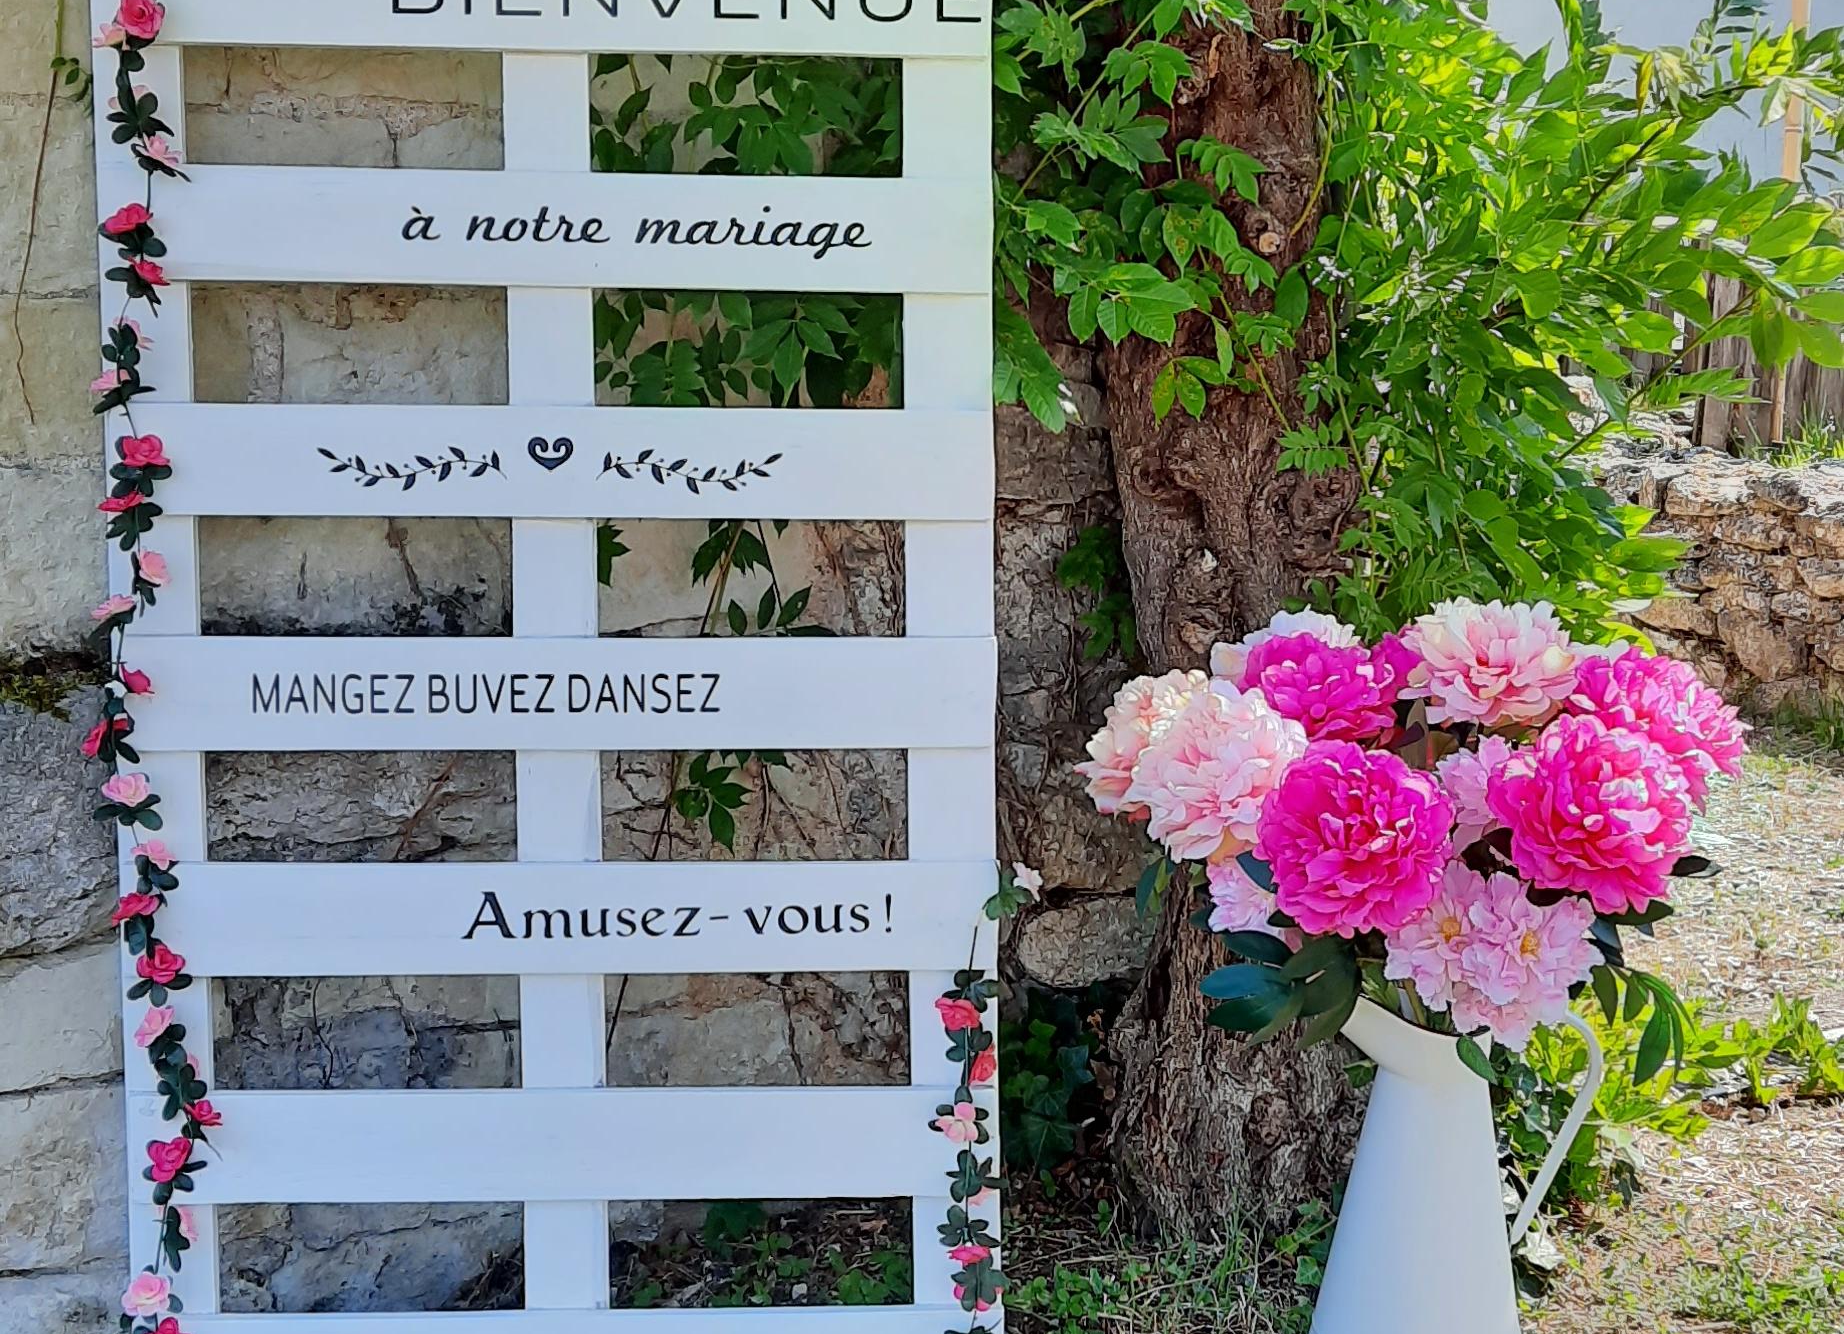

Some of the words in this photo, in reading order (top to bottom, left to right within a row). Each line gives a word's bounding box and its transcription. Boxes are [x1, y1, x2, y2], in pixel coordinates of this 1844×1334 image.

[401, 206, 441, 242] à
[465, 205, 611, 244] notre
[634, 205, 873, 260] mariage
[251, 672, 416, 715] MANGEZ
[427, 672, 557, 715] BUVEZ
[567, 672, 722, 715] DANSEZ
